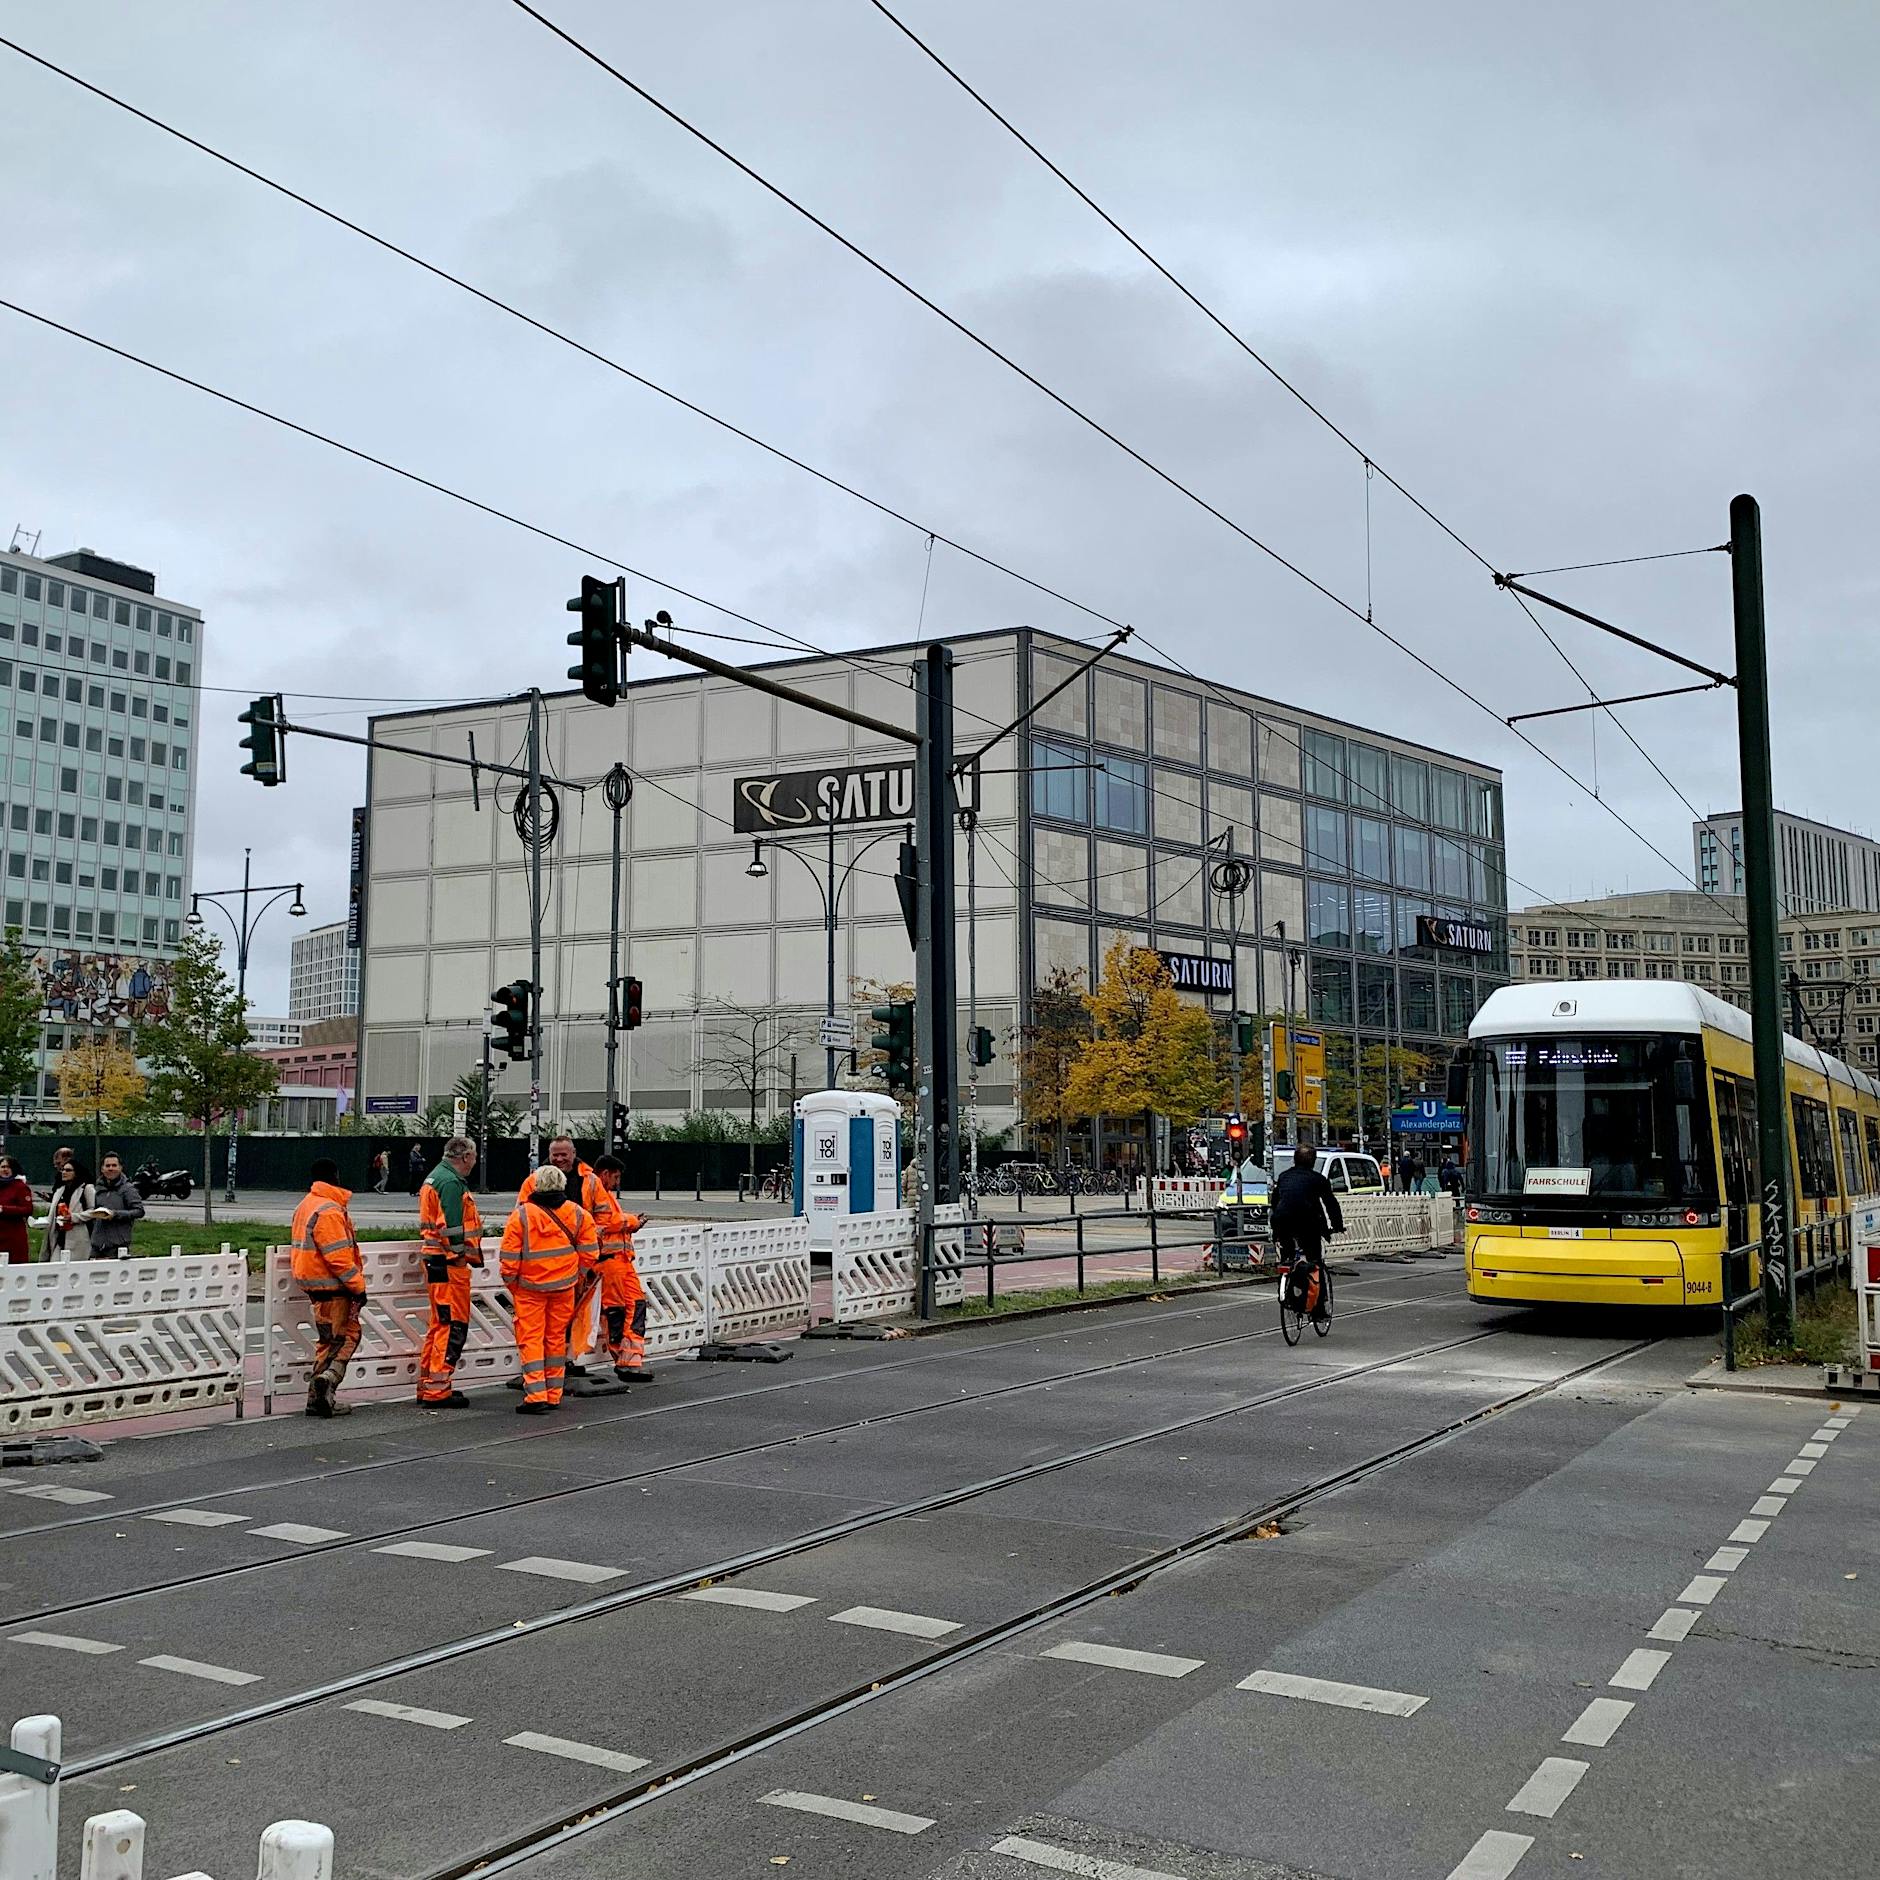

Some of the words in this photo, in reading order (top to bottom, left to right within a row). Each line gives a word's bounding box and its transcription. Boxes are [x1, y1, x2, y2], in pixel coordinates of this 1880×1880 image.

[817, 763, 972, 822] SATUN
[351, 832, 360, 870] SATURN
[348, 902, 357, 940] SATURN
[1448, 923, 1492, 952] SATURN
[1169, 956, 1232, 988] SATURN
[1423, 1101, 1436, 1118] U
[1400, 1120, 1460, 1130] Alexanderplatz
[819, 1149, 835, 1159] TOI
[1528, 1178, 1586, 1186] FAHRSCHULE
[1686, 1281, 1712, 1294] 9044-8
